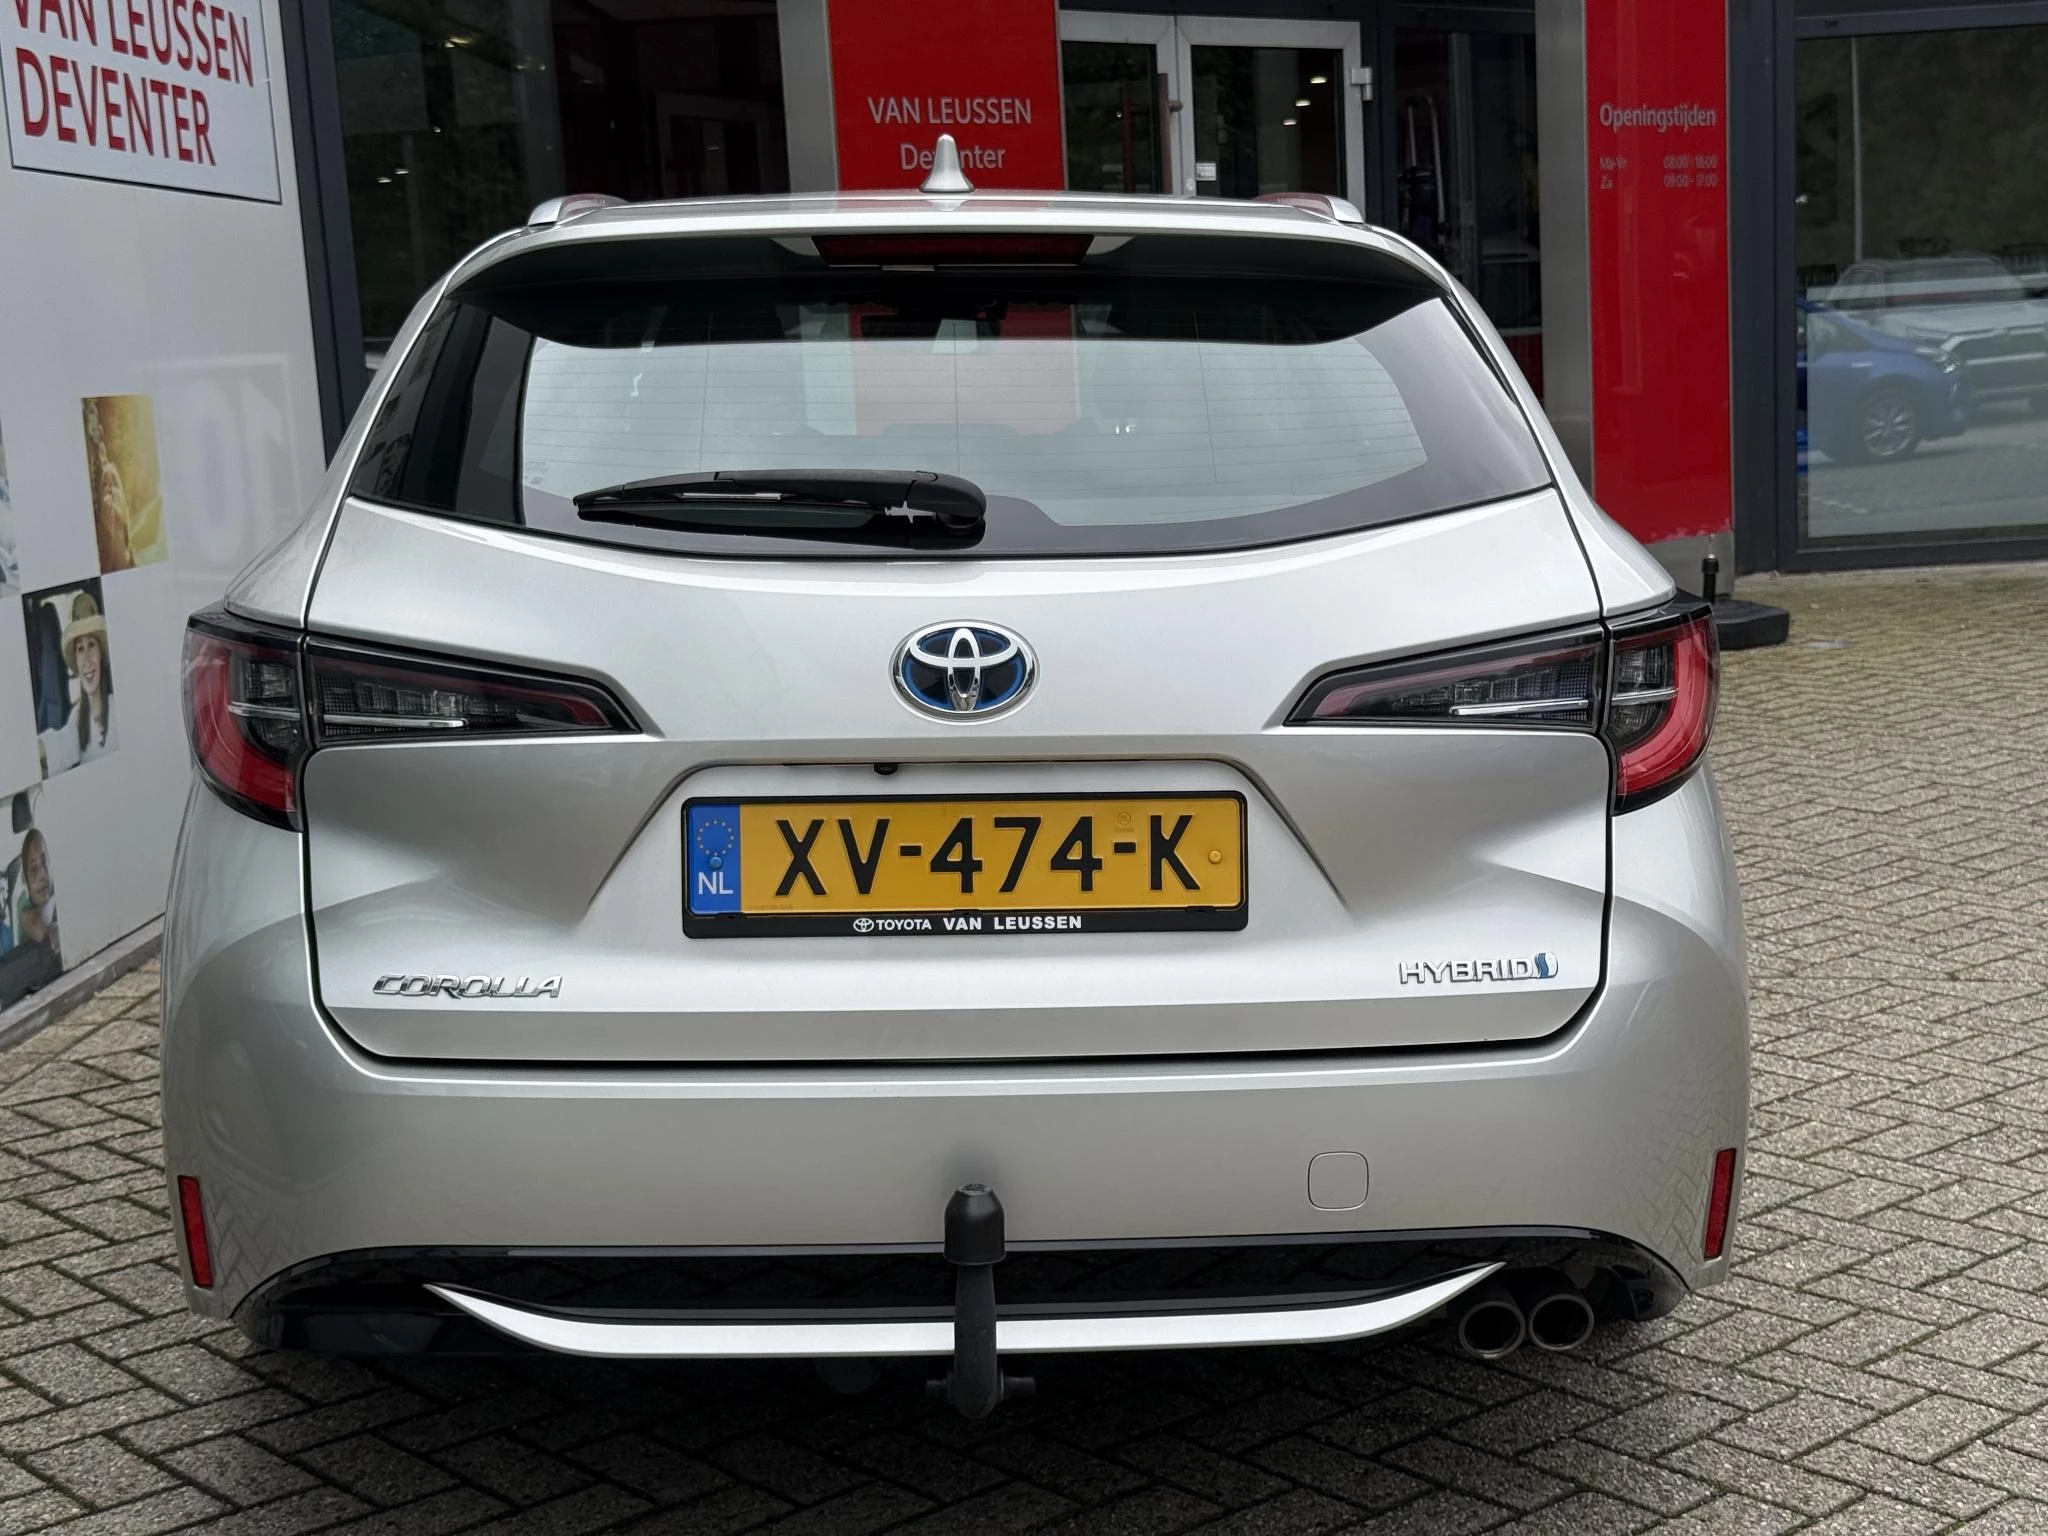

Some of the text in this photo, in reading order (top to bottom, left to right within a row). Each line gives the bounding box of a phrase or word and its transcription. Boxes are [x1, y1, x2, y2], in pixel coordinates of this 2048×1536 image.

[106, 0, 254, 88] LEUSSEN
[16, 47, 216, 166] DEVENTER
[867, 96, 1032, 124] VAN LEUSSEN
[1599, 102, 1716, 133] Openingstijden
[900, 144, 1005, 170] Denter
[774, 814, 1200, 896] XV-474-K
[698, 871, 734, 895] NL
[876, 915, 1082, 931] TOYOTA VAN LEUSSEN
[1399, 958, 1534, 985] HYBRID
[372, 973, 564, 1000] COROLLA
